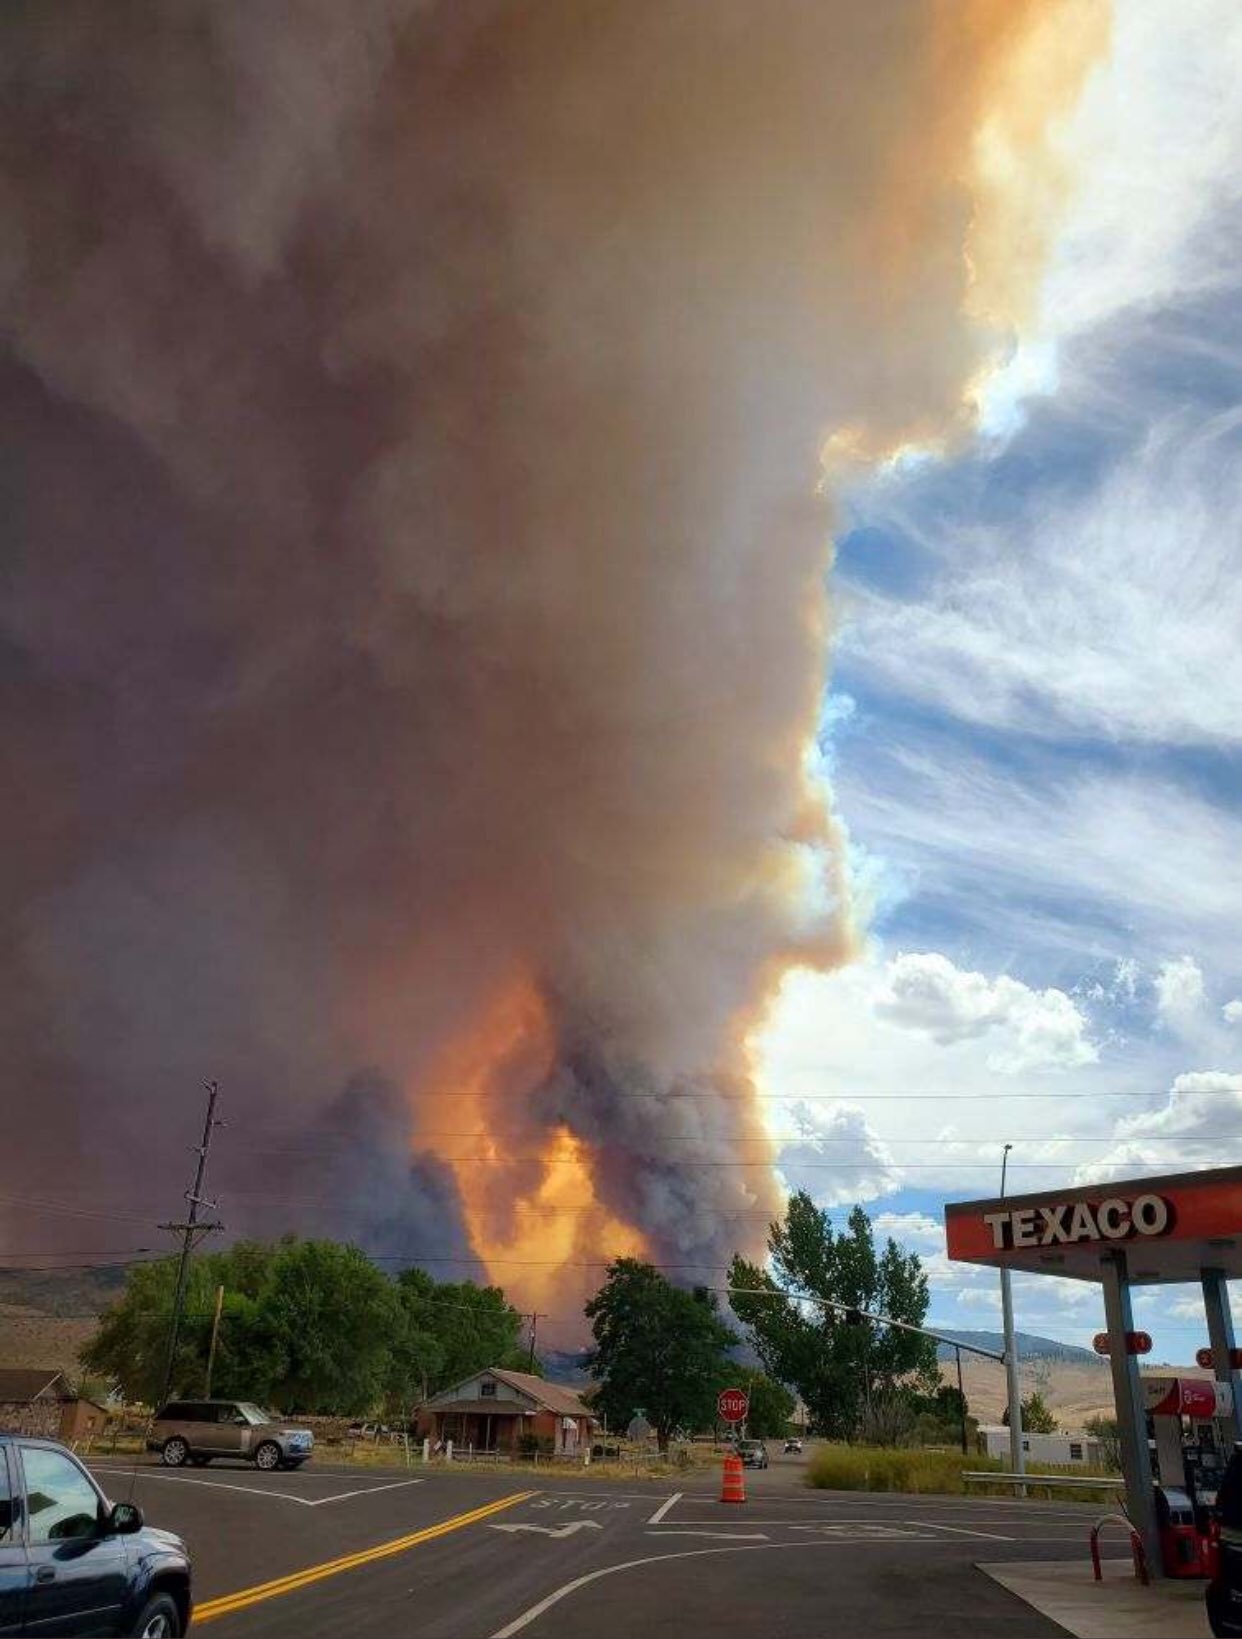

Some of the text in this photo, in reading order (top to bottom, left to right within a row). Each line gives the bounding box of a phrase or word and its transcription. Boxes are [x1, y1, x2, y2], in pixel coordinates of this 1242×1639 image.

[984, 1194, 1168, 1249] TEXACO
[721, 1399, 745, 1411] STOP
[530, 1499, 630, 1510] STOP
